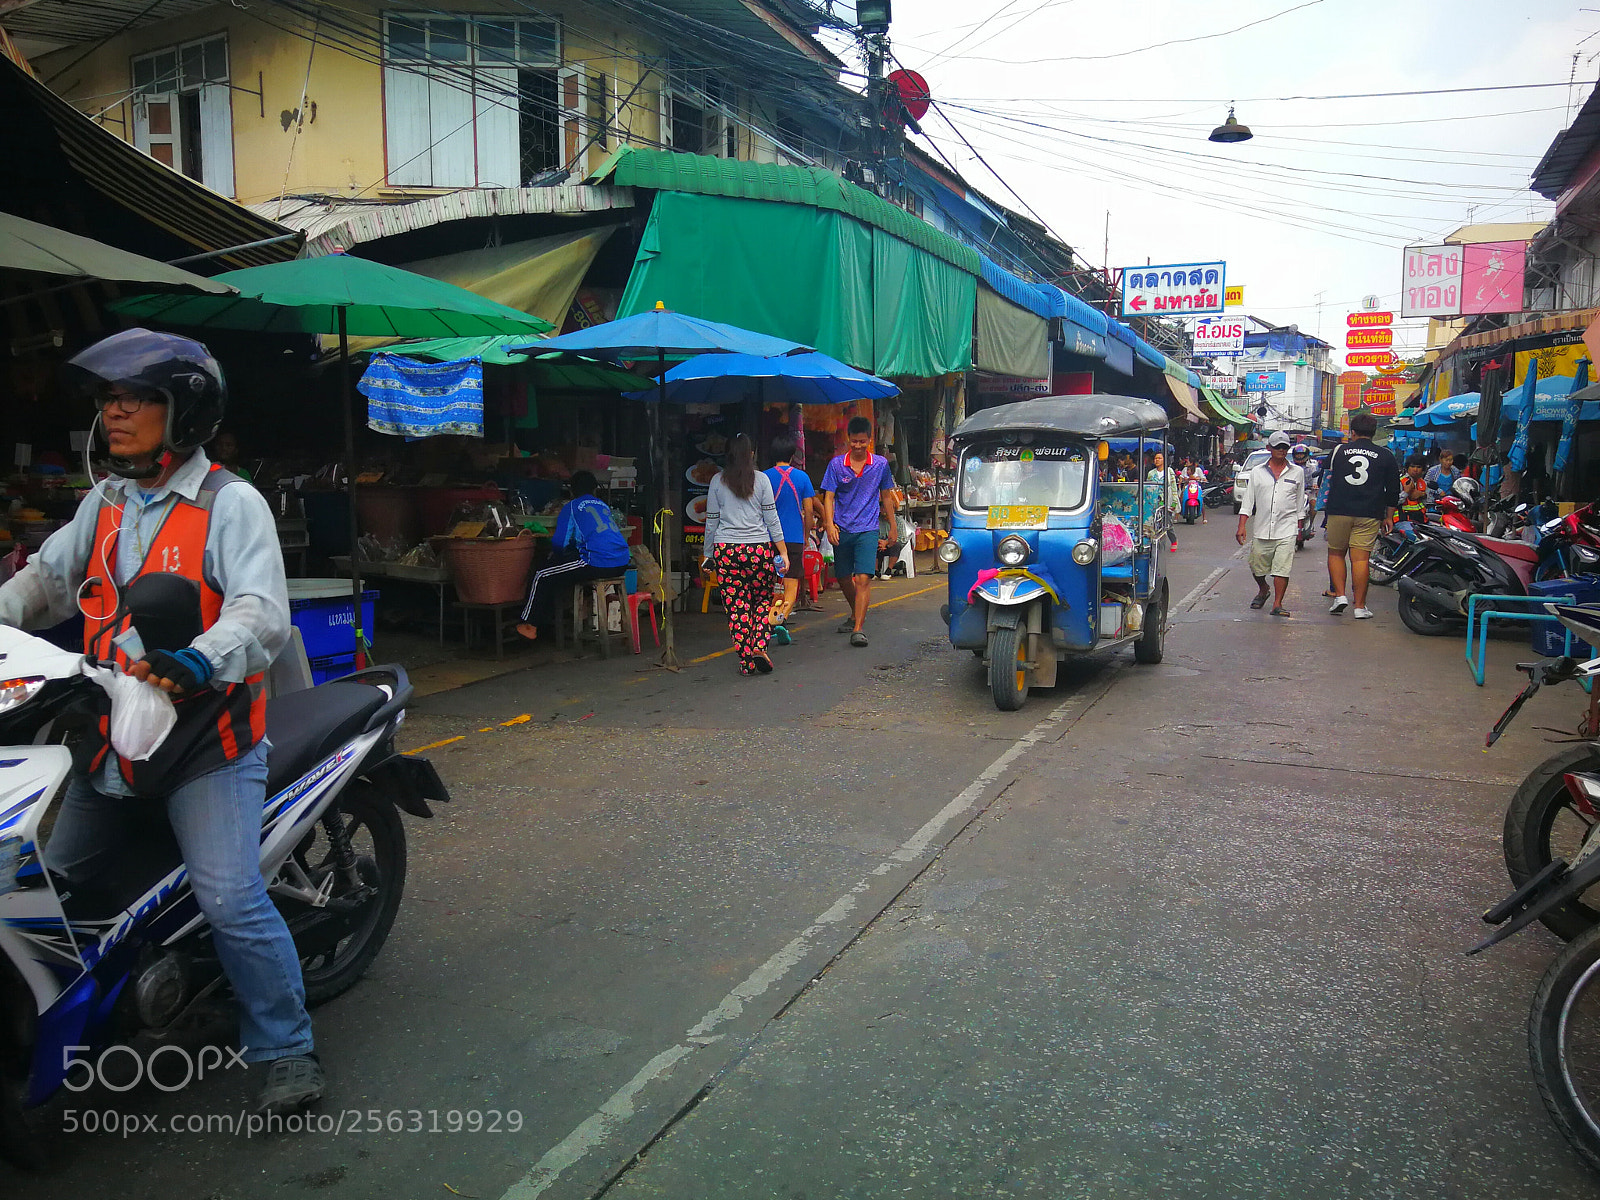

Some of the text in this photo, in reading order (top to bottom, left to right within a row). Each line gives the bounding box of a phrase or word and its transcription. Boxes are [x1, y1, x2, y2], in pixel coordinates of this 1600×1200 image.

[1409, 252, 1458, 278] แสง
[1130, 268, 1219, 289] ตลาดสด
[1154, 288, 1218, 310] มหาชัย
[1408, 284, 1457, 309] ทอง
[1349, 313, 1391, 325] ห้างทอง
[1196, 324, 1242, 339] ส.อมร
[1347, 354, 1391, 364] เยาวราช
[1344, 448, 1379, 459] HORMONES
[1344, 455, 1370, 486] 3
[161, 545, 181, 573] 13
